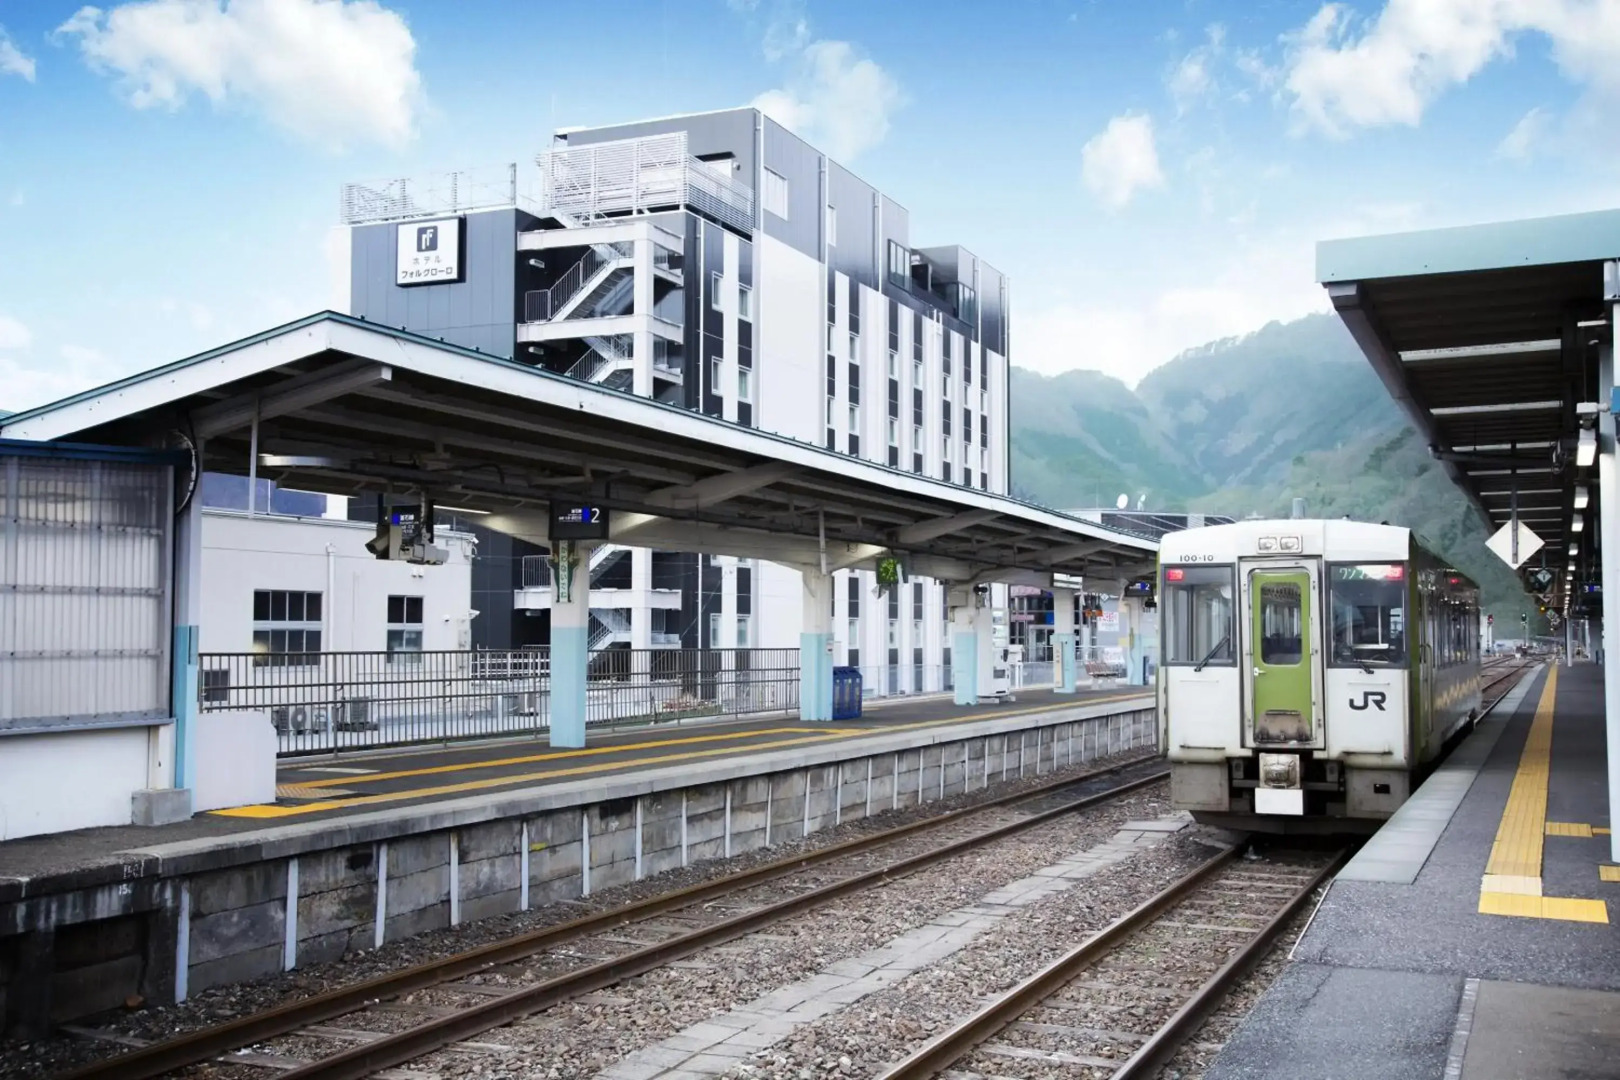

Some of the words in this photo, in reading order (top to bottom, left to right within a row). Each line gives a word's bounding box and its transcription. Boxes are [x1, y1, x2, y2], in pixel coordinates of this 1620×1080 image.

[412, 255, 442, 265] ホテル
[401, 266, 453, 279] フォルグローロ
[591, 507, 600, 523] 2
[1349, 691, 1386, 711] JR
